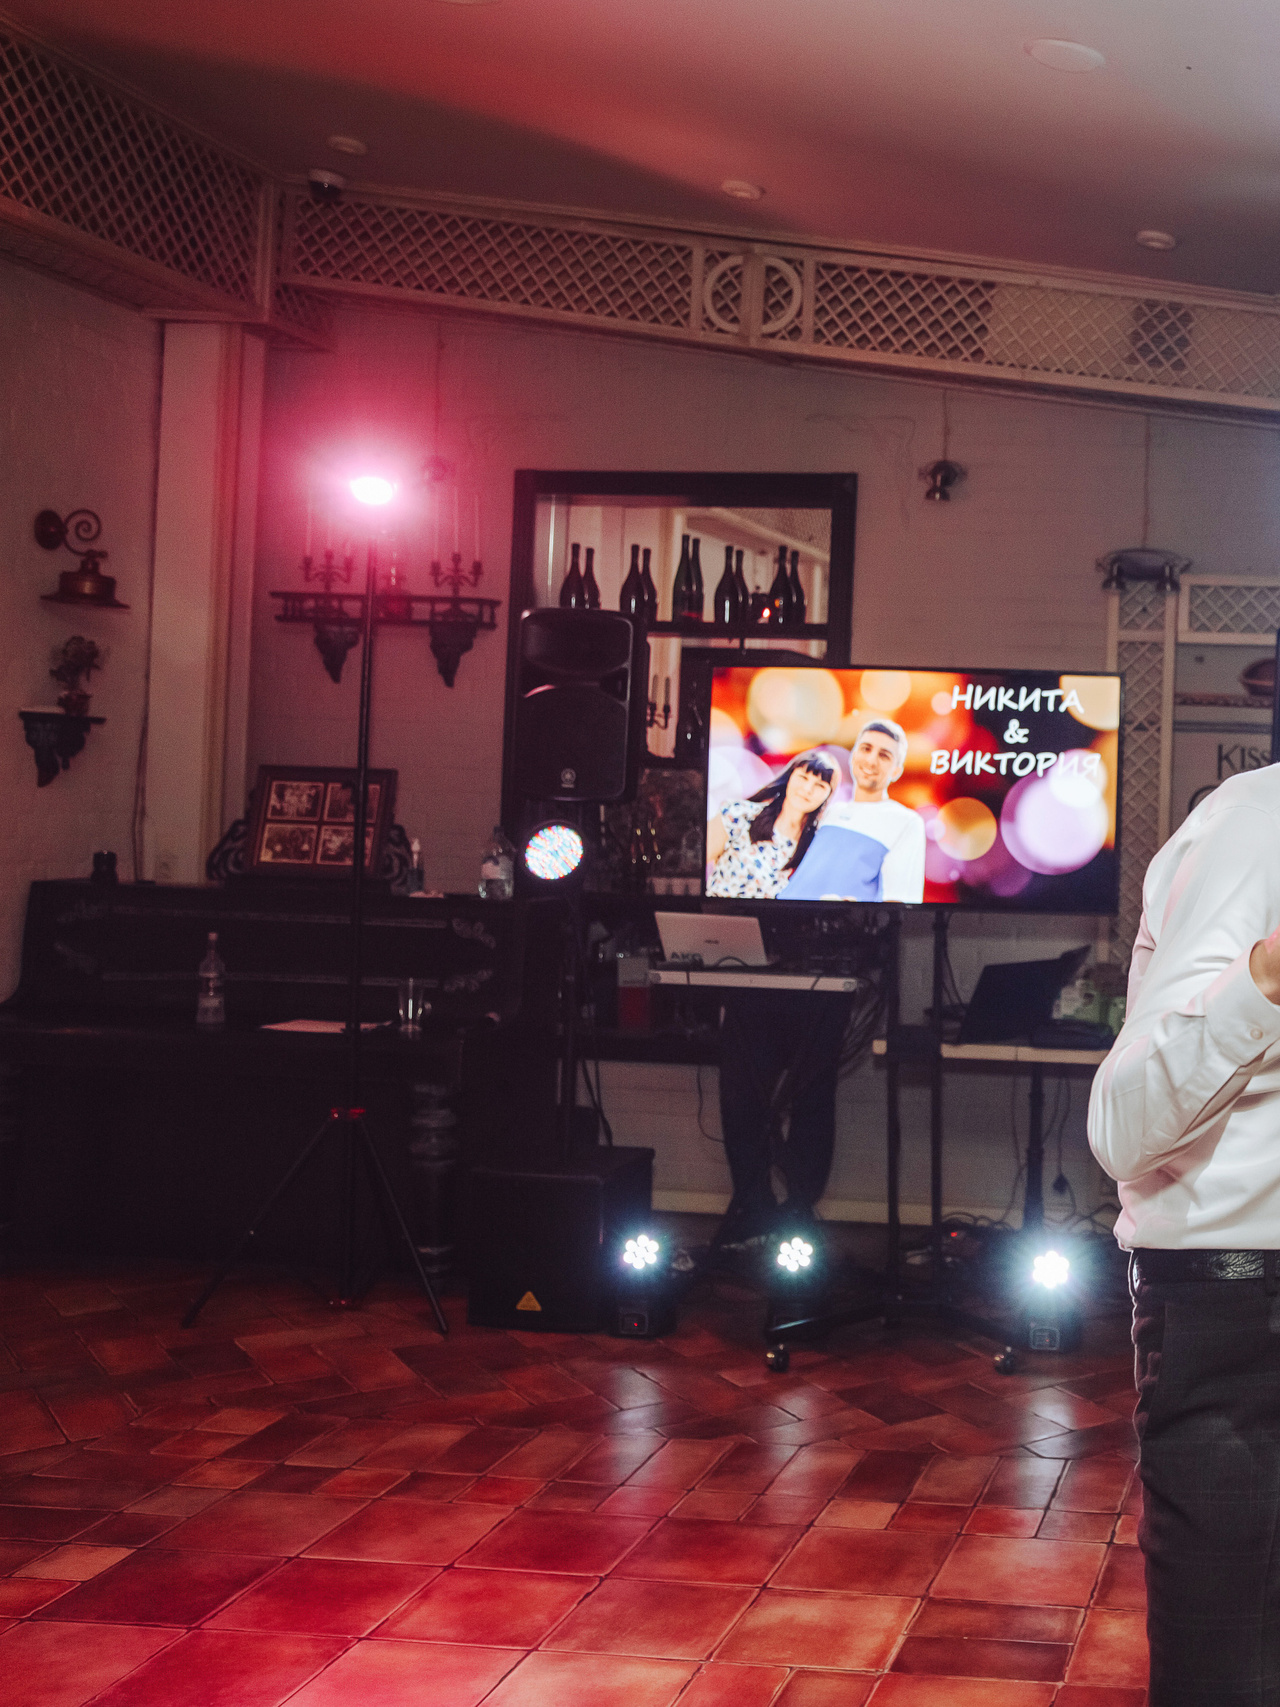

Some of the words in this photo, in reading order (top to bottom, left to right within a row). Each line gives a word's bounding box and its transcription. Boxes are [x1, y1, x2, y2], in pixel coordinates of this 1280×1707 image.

[951, 684, 1085, 713] НИКИТА
[1003, 718, 1030, 744] &
[930, 749, 1101, 777] ВИКТОРИЯ
